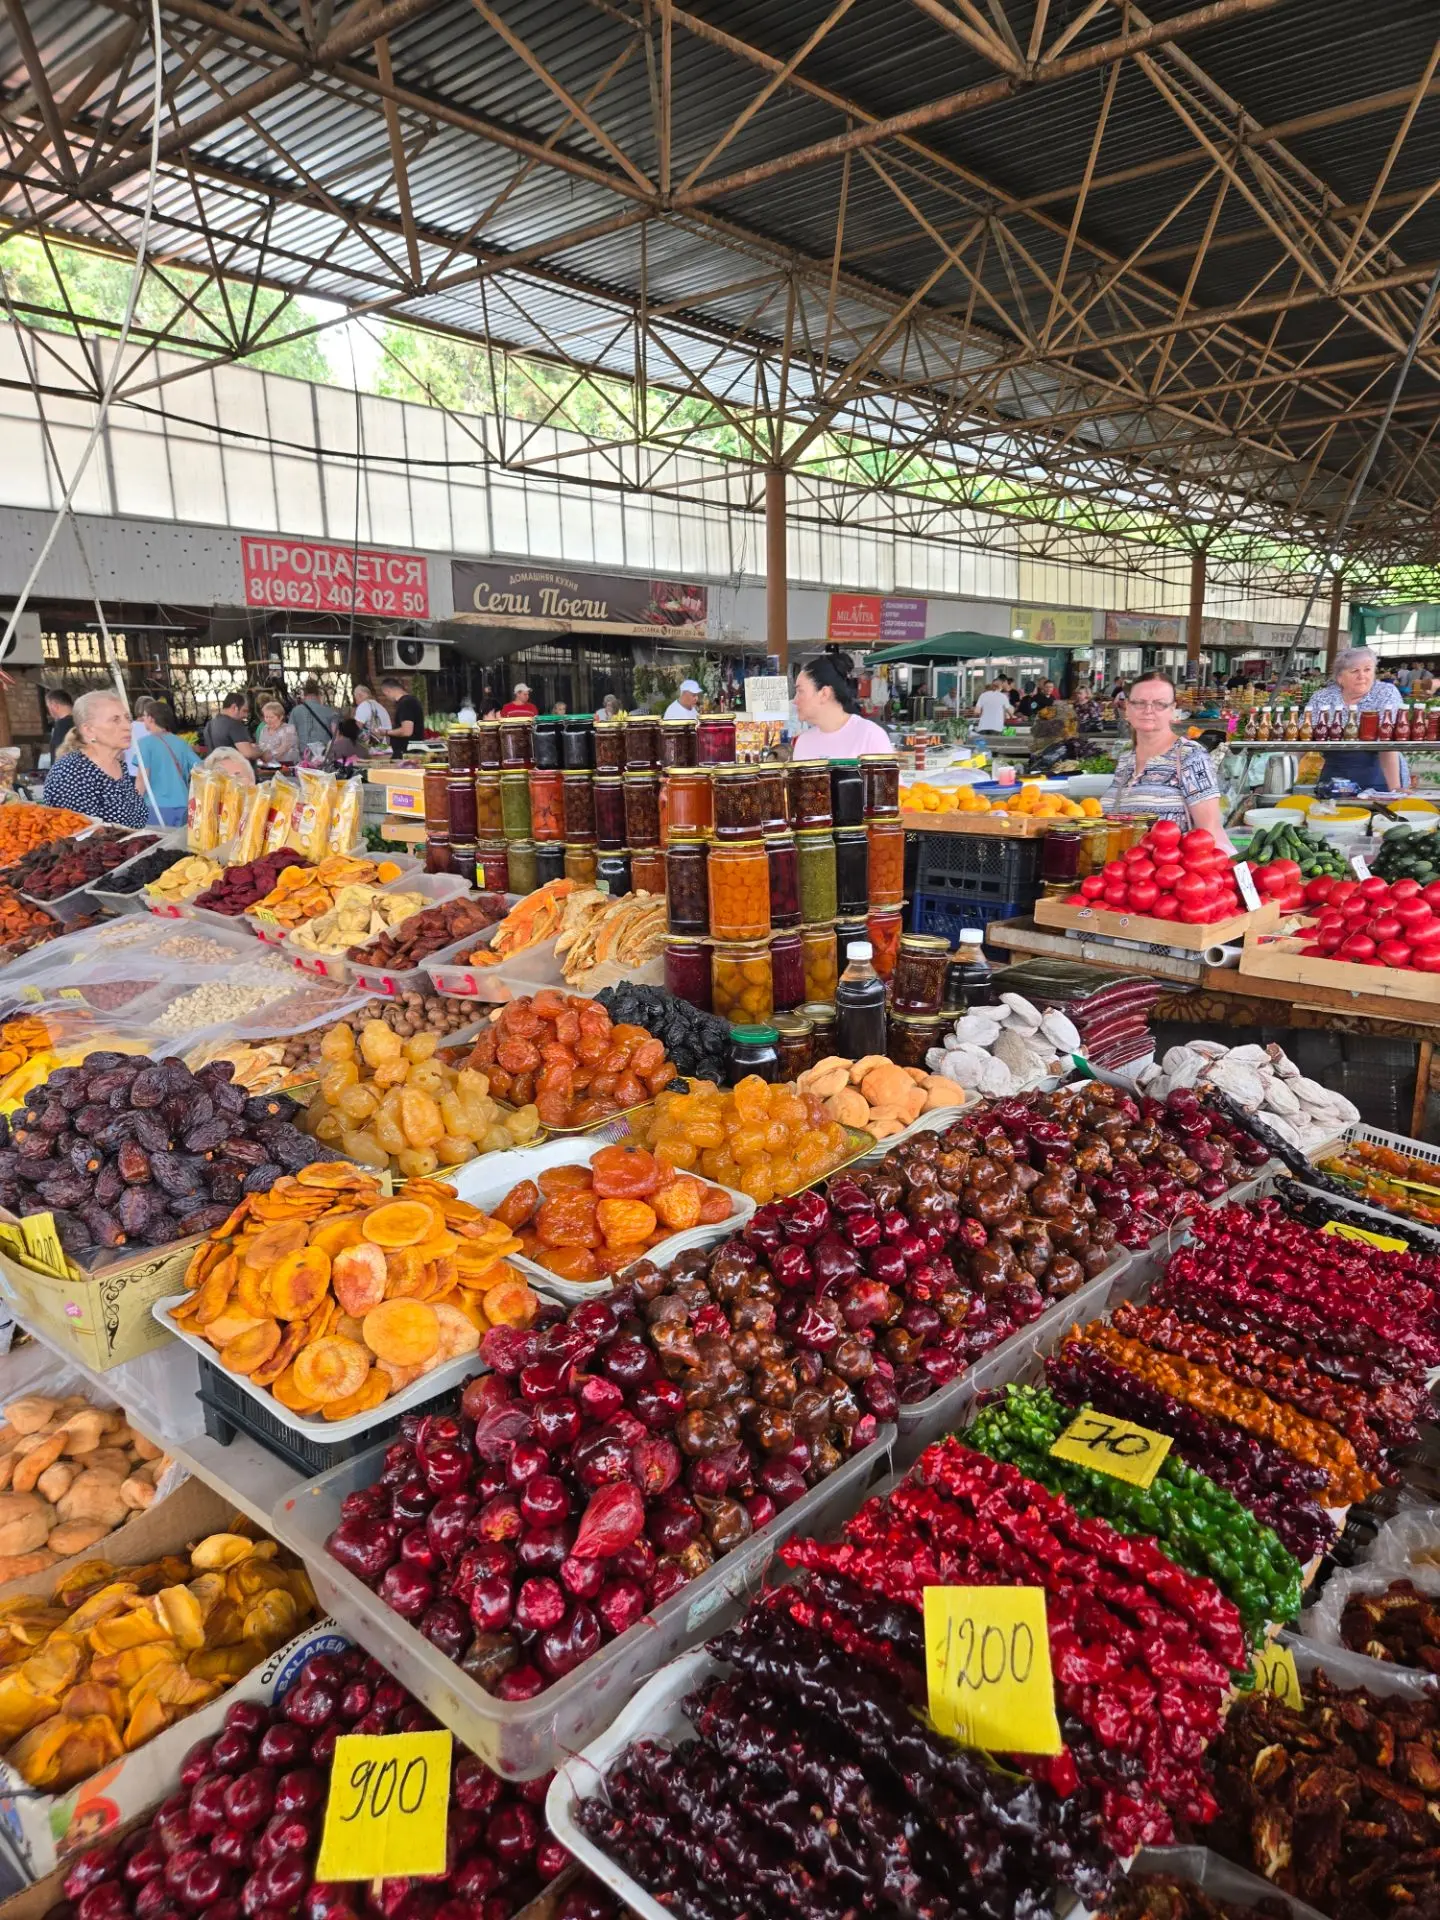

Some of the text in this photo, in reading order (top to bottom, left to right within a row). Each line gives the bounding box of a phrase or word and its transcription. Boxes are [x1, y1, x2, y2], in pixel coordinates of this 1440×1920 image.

[247, 543, 423, 586] ПРОДАЕТСЯ
[509, 572, 579, 591] ДОМАШНЯЯ КУХНЯ
[250, 578, 424, 612] 8(962) 402 02 50
[473, 583, 608, 619] Сели Поели
[1067, 1419, 1151, 1457] 70
[941, 1615, 1034, 1695] 1200
[339, 1755, 428, 1821] 900
